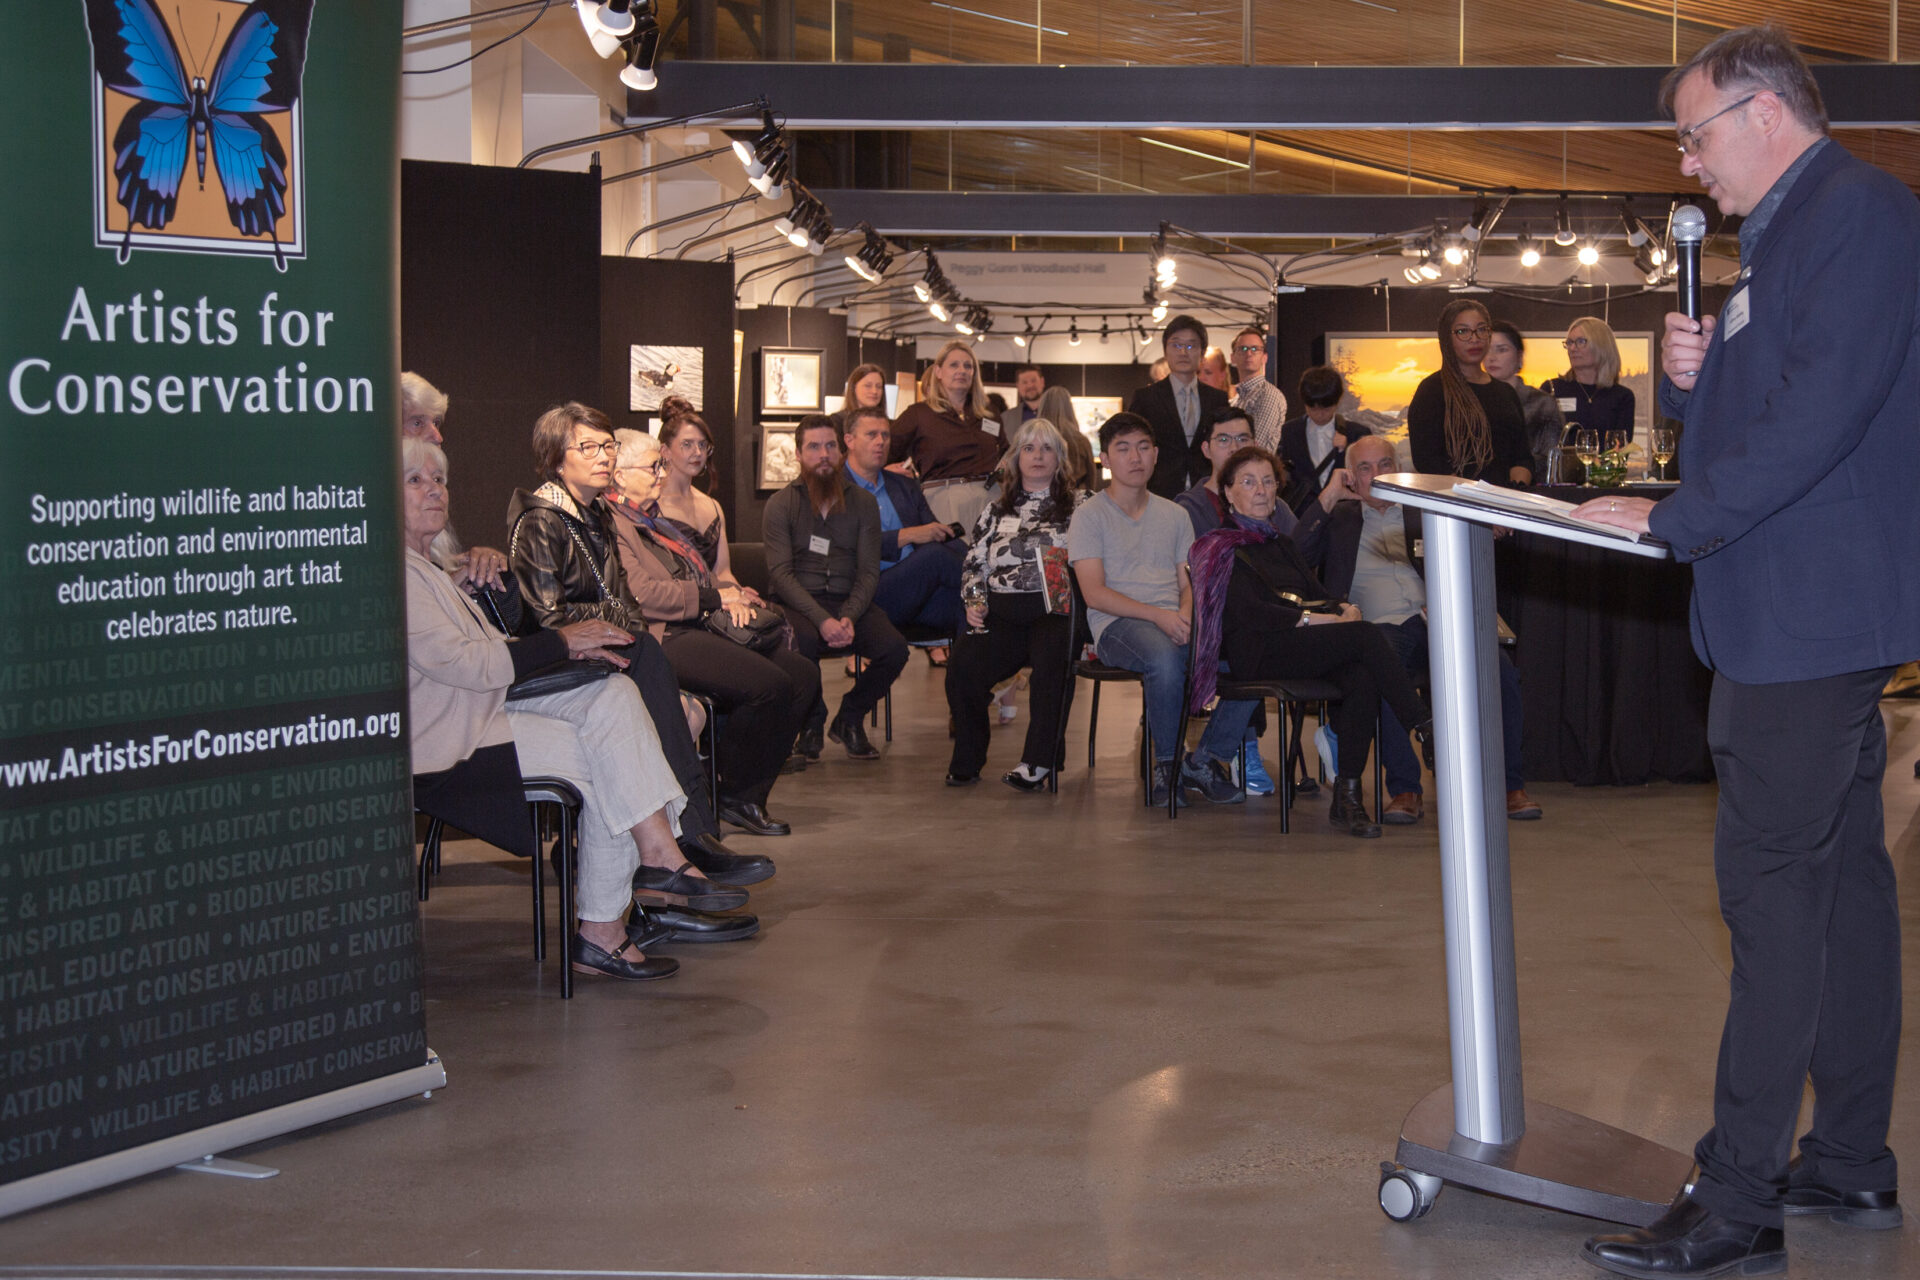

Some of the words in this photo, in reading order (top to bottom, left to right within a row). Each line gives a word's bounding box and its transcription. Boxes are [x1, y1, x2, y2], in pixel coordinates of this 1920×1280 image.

[1022, 262, 1080, 274] Woodland
[61, 286, 238, 346] Artists
[259, 292, 334, 347] for
[8, 358, 374, 415] Conservation
[31, 491, 156, 527] Supporting
[162, 487, 242, 517] wildlife
[248, 485, 286, 512] and
[293, 484, 367, 511] habitat
[27, 531, 169, 566] conservation
[176, 527, 215, 555] and
[221, 520, 368, 553] environmental
[58, 572, 166, 604] education
[174, 564, 255, 595] through
[263, 563, 294, 588] art
[300, 560, 343, 585] that
[107, 610, 217, 640] celebrates
[224, 604, 298, 631] nature.
[106, 641, 247, 680] EDUCATION
[32, 669, 225, 726] CONSERVATION
[0, 712, 400, 788] ww.ArtistsForConservation.org
[49, 781, 242, 836] CONSERVATION
[271, 757, 405, 799] ENVIRONME
[18, 892, 38, 919] &
[48, 869, 157, 913] HABITAT
[164, 834, 346, 891] CONSERVATION
[20, 833, 145, 879] WILDLIFE
[154, 829, 173, 855] &
[181, 810, 281, 850] HABITAT
[130, 900, 179, 933] ART
[207, 863, 370, 918] BIODIVERSITY
[0, 966, 55, 1001] TAL
[64, 931, 210, 986] EDUCATION
[16, 985, 128, 1035] HABITAT
[137, 942, 320, 1006] CONSERVATION
[119, 998, 239, 1049] WILDLIFE
[247, 992, 264, 1017] &
[272, 967, 366, 1011] HABITAT
[1, 1075, 83, 1121] ATION
[117, 1012, 336, 1090] NATURE-INSPIRED
[343, 999, 386, 1032] ART
[90, 1089, 200, 1139] WILDLIFE
[207, 1083, 224, 1107] &
[231, 1057, 317, 1101] HABITAT
[323, 1029, 425, 1074] CONSERVA
